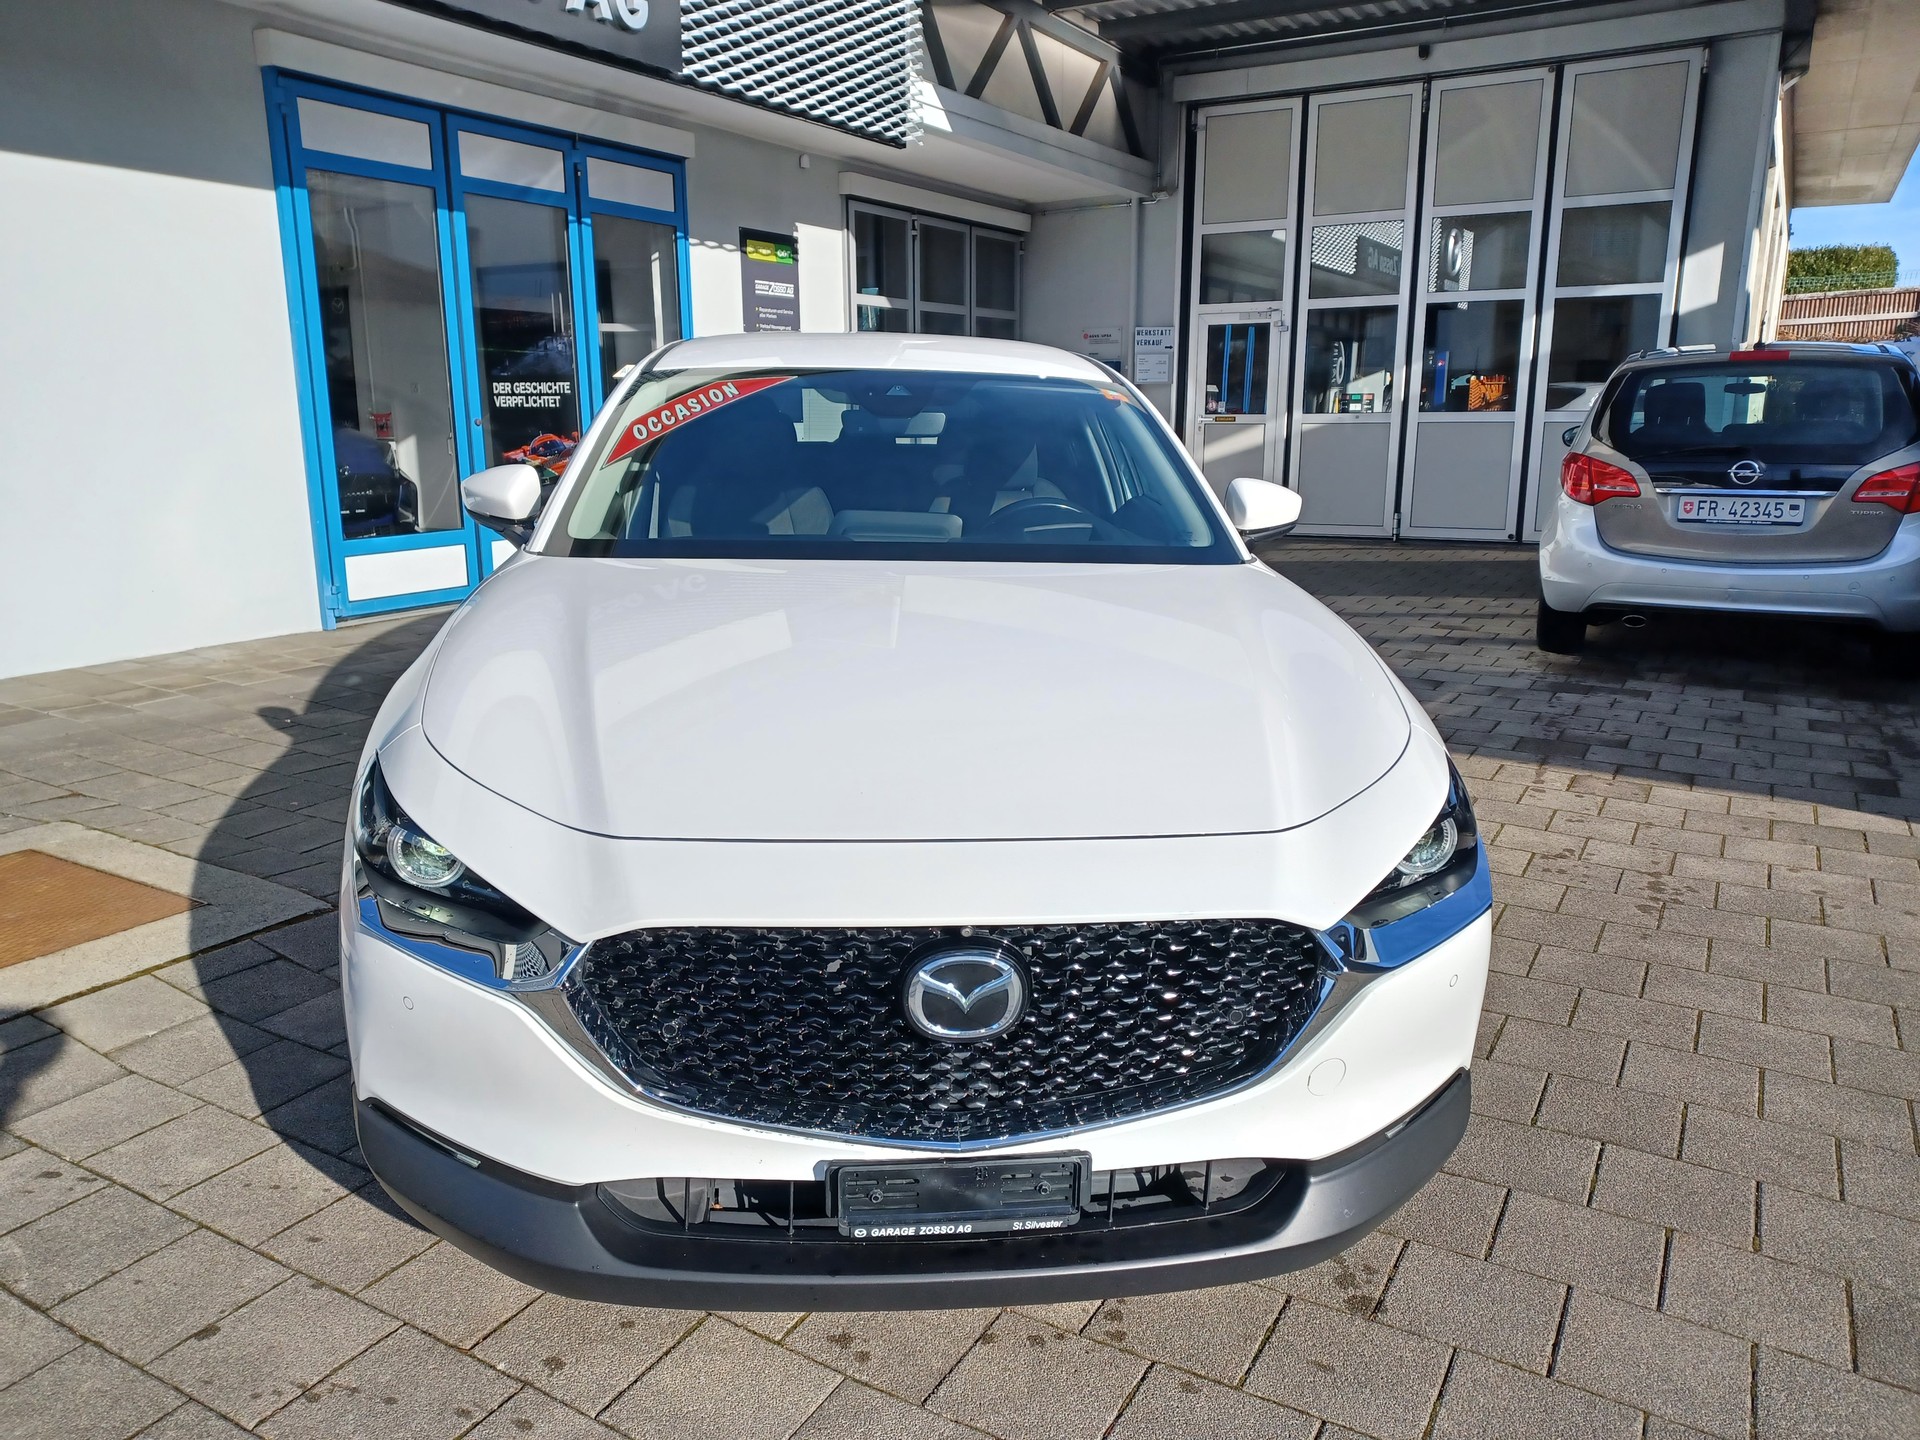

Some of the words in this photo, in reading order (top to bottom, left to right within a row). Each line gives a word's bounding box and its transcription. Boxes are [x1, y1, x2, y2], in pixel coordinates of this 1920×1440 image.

[492, 382, 512, 394] DER
[513, 382, 571, 394] GESCHICHTE
[494, 396, 561, 408] VERPFLICHTET
[632, 382, 741, 440] OCCASION
[1697, 500, 1719, 517] FR
[1729, 501, 1785, 519] 42345
[870, 1228, 915, 1237] GARAGE
[918, 1226, 954, 1235] ZOSSO
[956, 1225, 972, 1233] AG
